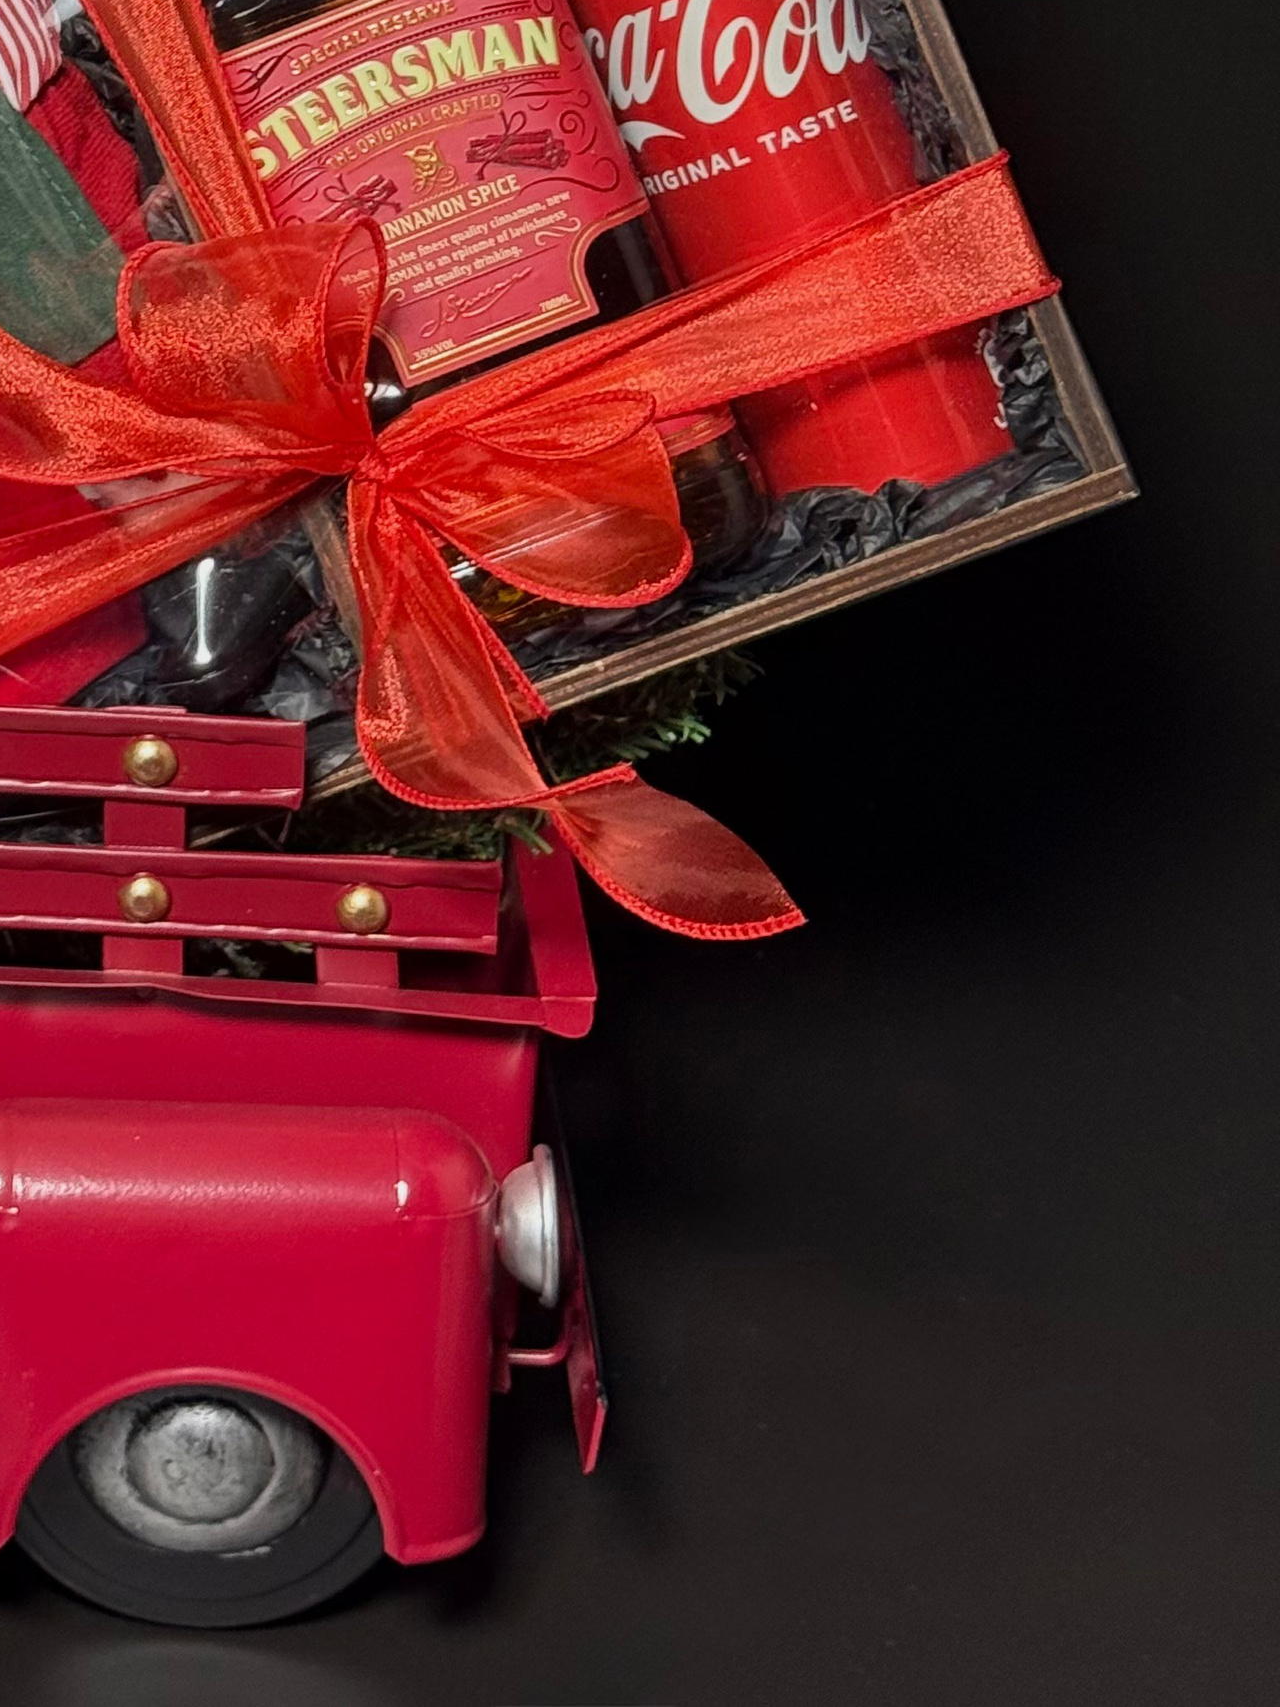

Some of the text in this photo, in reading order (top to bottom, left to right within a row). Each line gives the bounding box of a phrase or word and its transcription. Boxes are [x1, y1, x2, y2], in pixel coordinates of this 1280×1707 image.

[288, 29, 368, 76] SPECIAL
[245, 15, 561, 181] STEERSMAN
[357, 110, 431, 156] ORIGINAL
[430, 93, 503, 122] CRAFTED
[644, 98, 859, 196] RIGINAL TASTE
[381, 173, 521, 241] INNAMON SPICE
[398, 251, 418, 265] the
[450, 221, 489, 246] quality
[424, 260, 436, 272] is
[436, 255, 452, 267] an
[496, 230, 510, 245] of
[412, 276, 434, 294] and
[433, 265, 472, 289] quality
